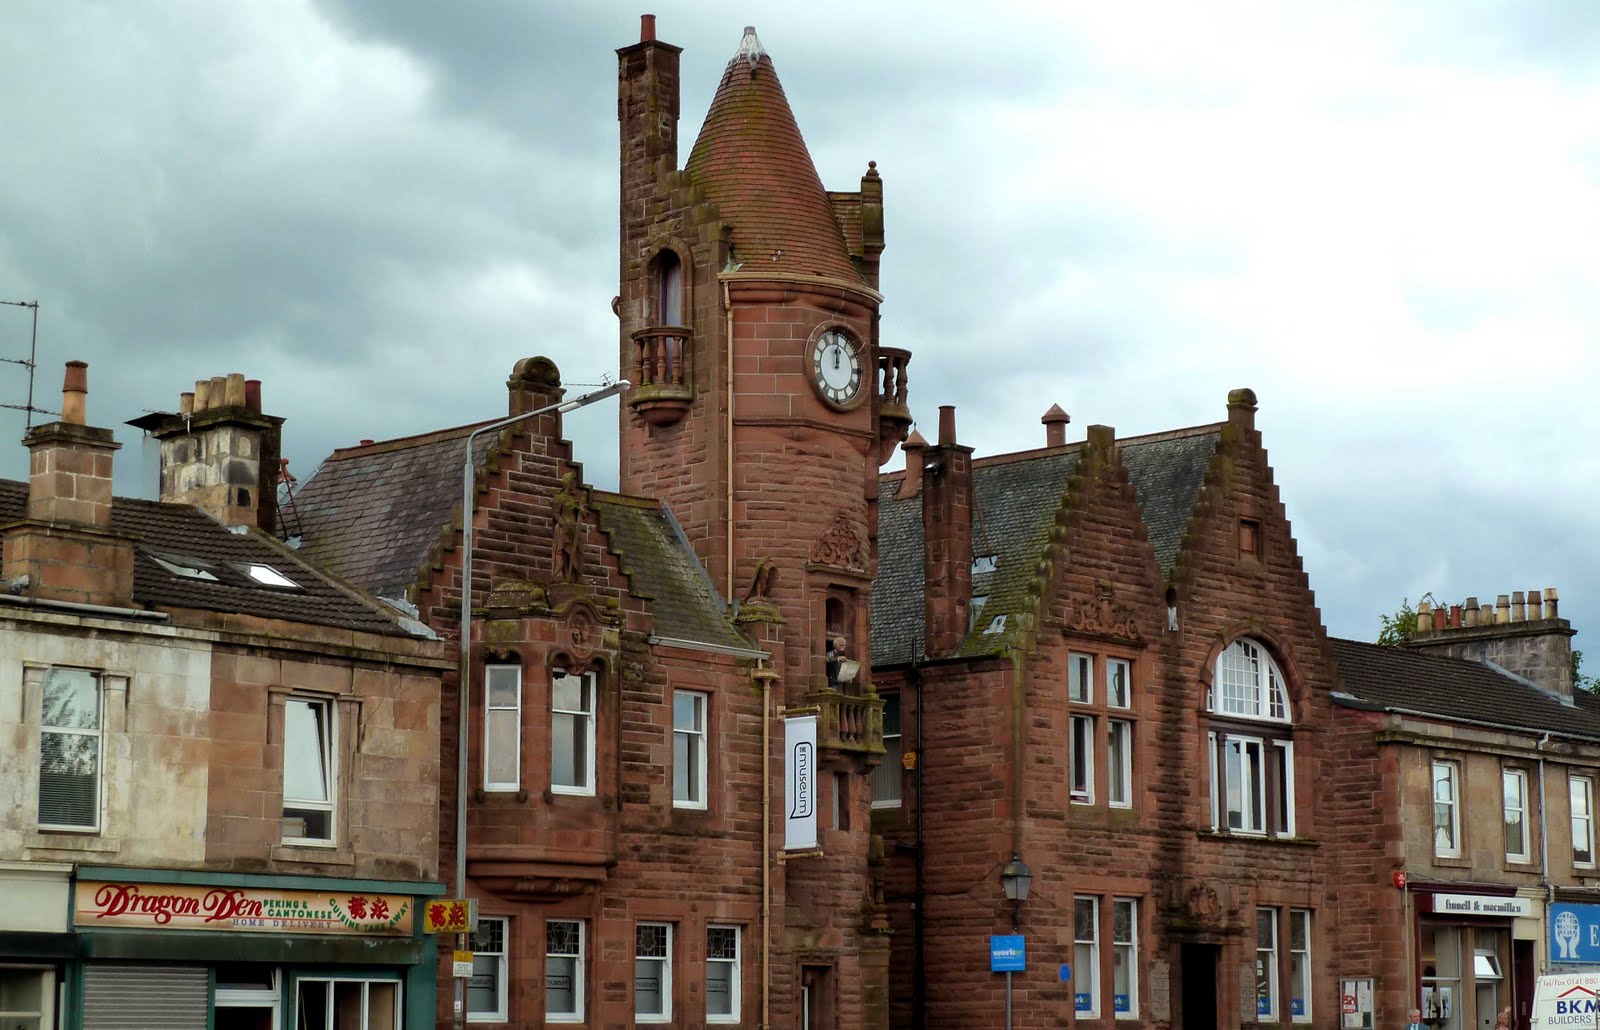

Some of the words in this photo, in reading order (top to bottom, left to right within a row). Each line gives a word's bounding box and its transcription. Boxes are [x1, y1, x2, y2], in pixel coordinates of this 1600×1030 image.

[799, 753, 807, 814] museum
[95, 884, 200, 925] Dragon
[203, 888, 263, 923] Den
[263, 899, 299, 909] PEKING
[302, 900, 308, 909] &
[1473, 900, 1480, 911] &
[268, 908, 333, 919] CANTONESE
[329, 898, 360, 931] CUISINE
[363, 923, 386, 932] TAKE
[389, 901, 409, 928] AWAY
[273, 920, 332, 929] DELIVERY
[1543, 979, 1565, 987] Tel/Fax
[1566, 978, 1582, 986] 0141
[1556, 1000, 1600, 1014] BKM
[1548, 1015, 1592, 1025] BUILDERS
